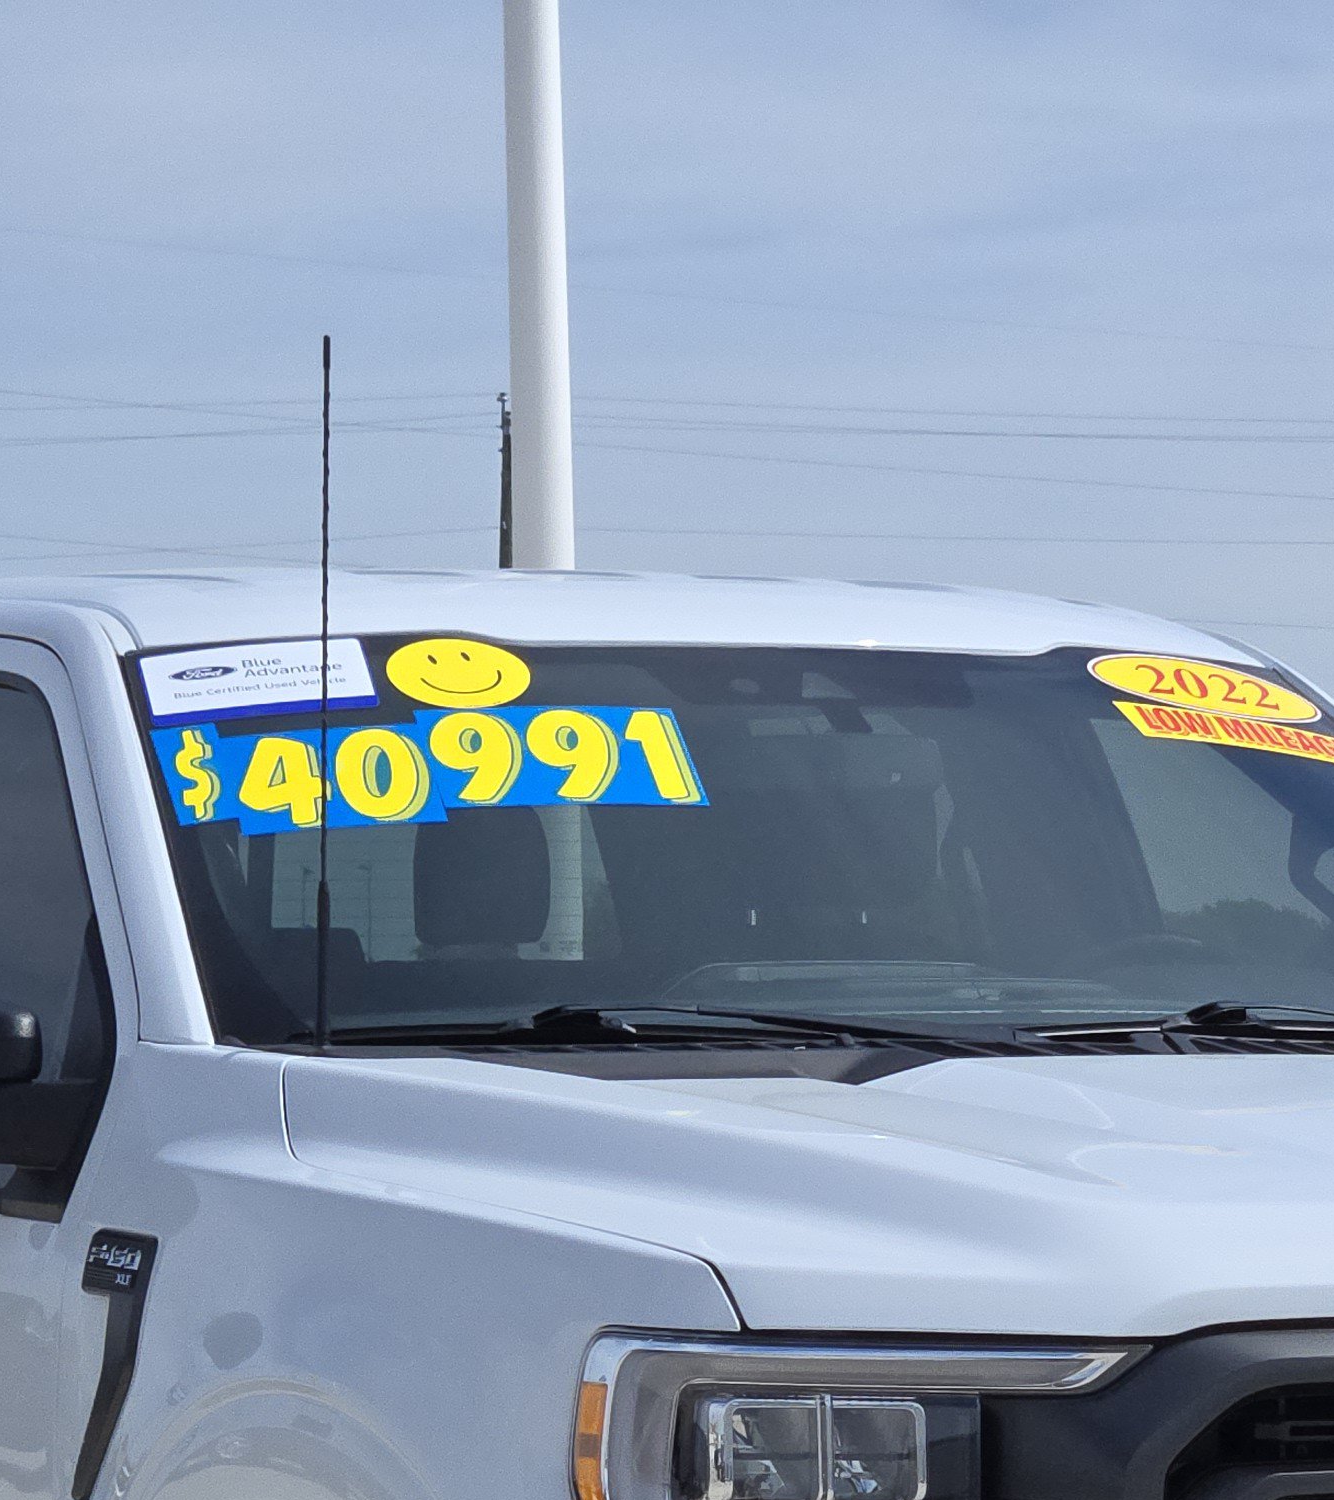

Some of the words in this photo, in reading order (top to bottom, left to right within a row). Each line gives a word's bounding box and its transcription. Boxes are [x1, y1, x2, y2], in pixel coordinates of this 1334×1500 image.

[182, 667, 223, 680] Ford
[241, 657, 282, 669] Blue
[173, 690, 203, 700] Blue
[206, 683, 261, 696] Certified
[265, 679, 297, 690] Used
[1134, 663, 1280, 711] 2022
[1133, 704, 1218, 738] LOW
